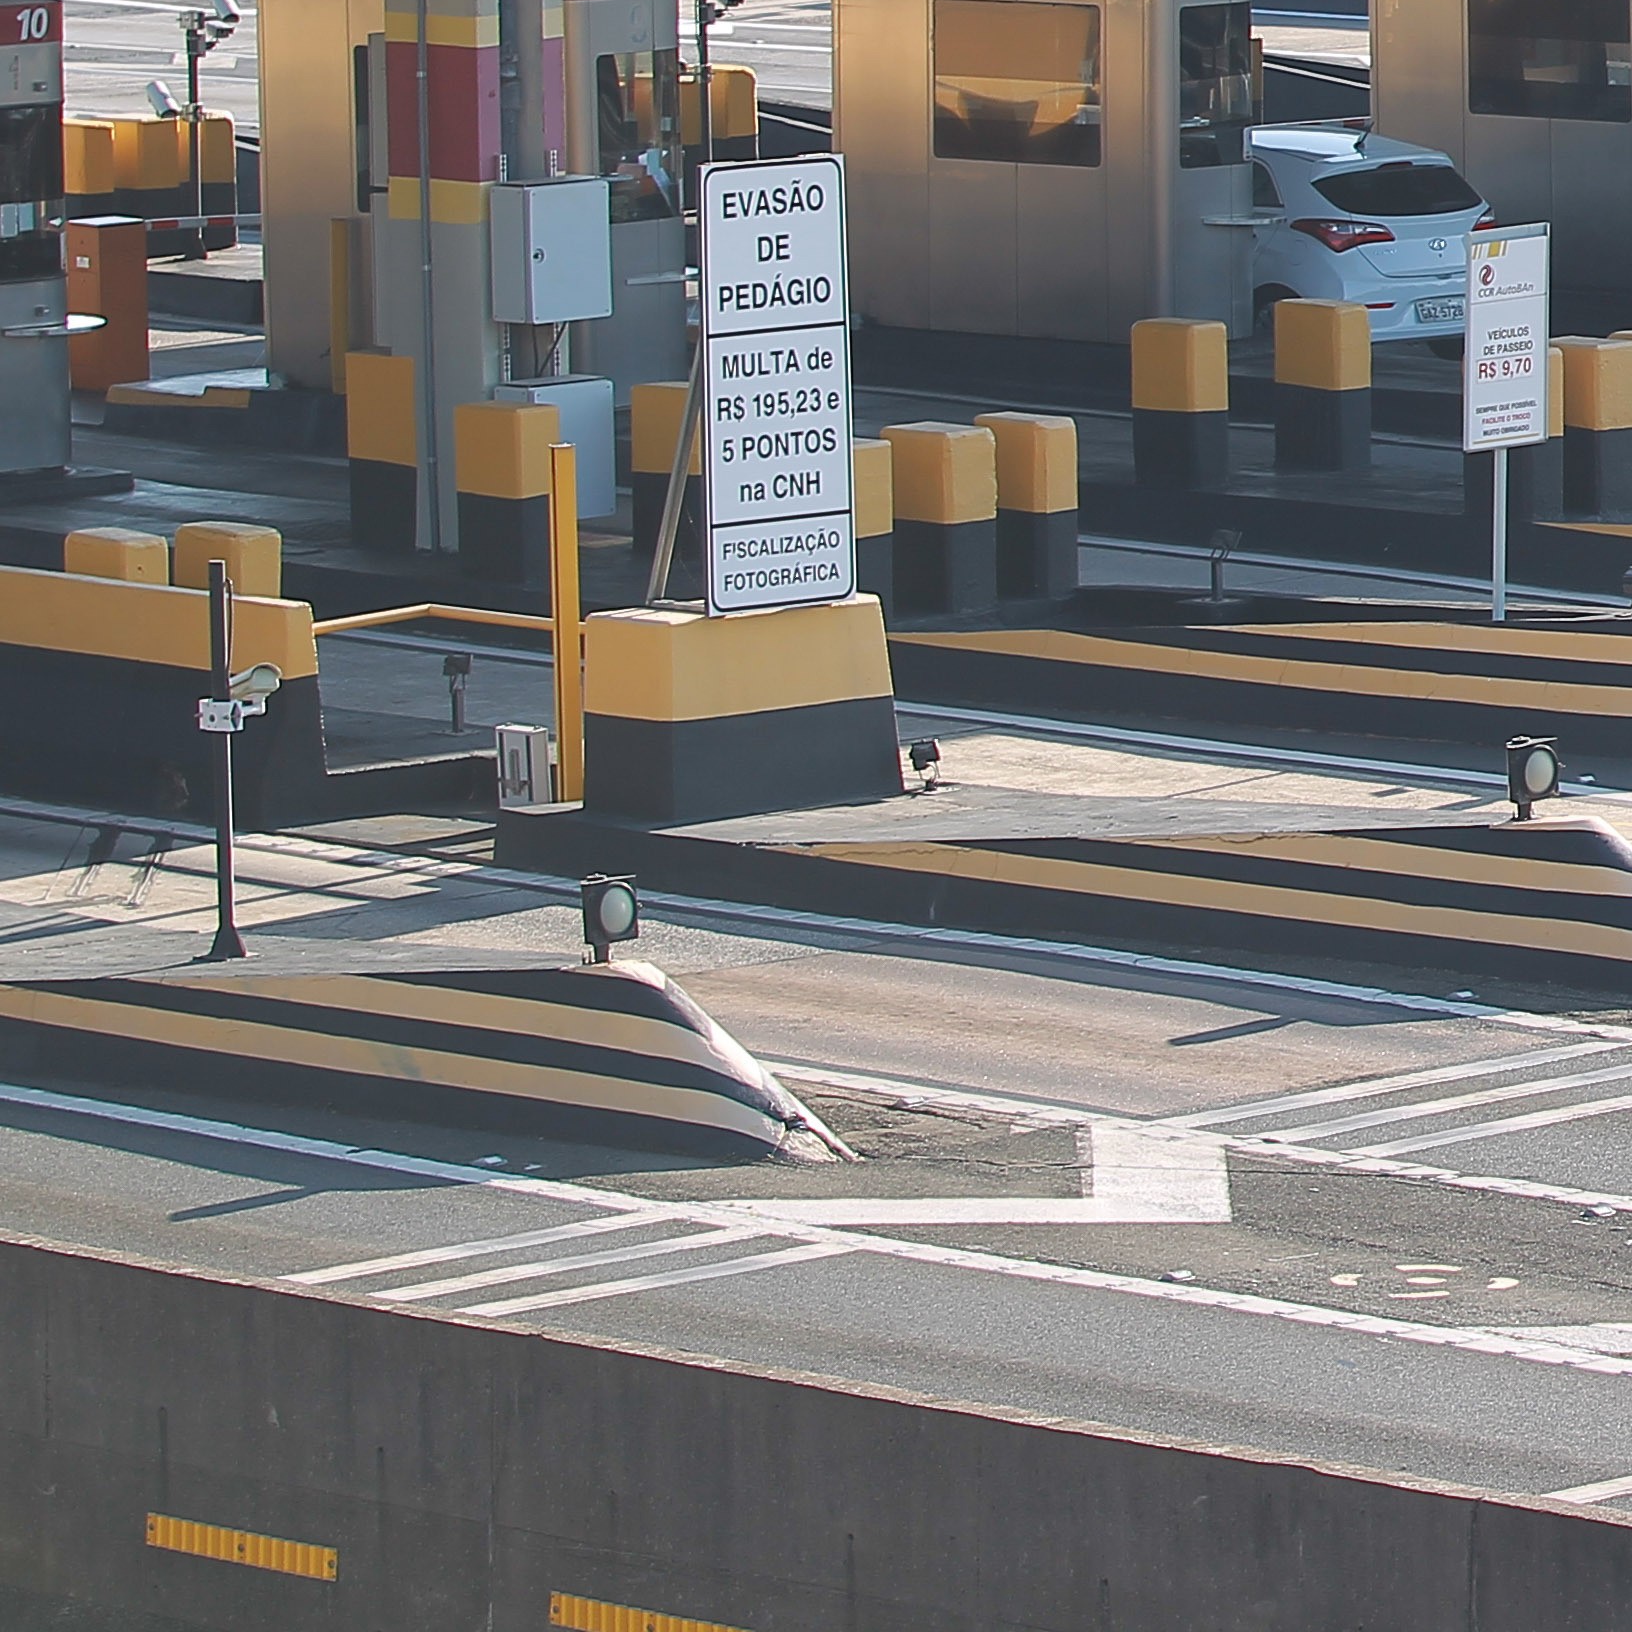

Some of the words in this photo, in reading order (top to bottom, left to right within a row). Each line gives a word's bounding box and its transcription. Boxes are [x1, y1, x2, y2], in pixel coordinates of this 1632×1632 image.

[16, 7, 48, 41] 10
[721, 179, 825, 219] EVASÃO
[757, 234, 792, 264] DE
[718, 273, 832, 313] PEDÁGIO
[1478, 288, 1494, 298] CCR
[1495, 283, 1534, 296] AutoBAn
[1483, 345, 1494, 355] DE
[1497, 340, 1533, 353] PASSEIO
[1487, 326, 1529, 340] VEÍCULOS
[721, 349, 801, 381] MULTA
[806, 347, 834, 373] de
[1478, 362, 1496, 380] R$
[1502, 357, 1532, 379] 9,70
[716, 394, 746, 424] R$
[752, 388, 824, 420] 195,23
[827, 392, 840, 411] e
[722, 439, 735, 463] 5
[741, 427, 838, 461] PONTOS
[739, 479, 766, 503] na
[773, 472, 822, 499] CNH
[722, 528, 841, 561] FISCALIZAÇÃO
[723, 561, 841, 592] FOTOGRÁFICA
